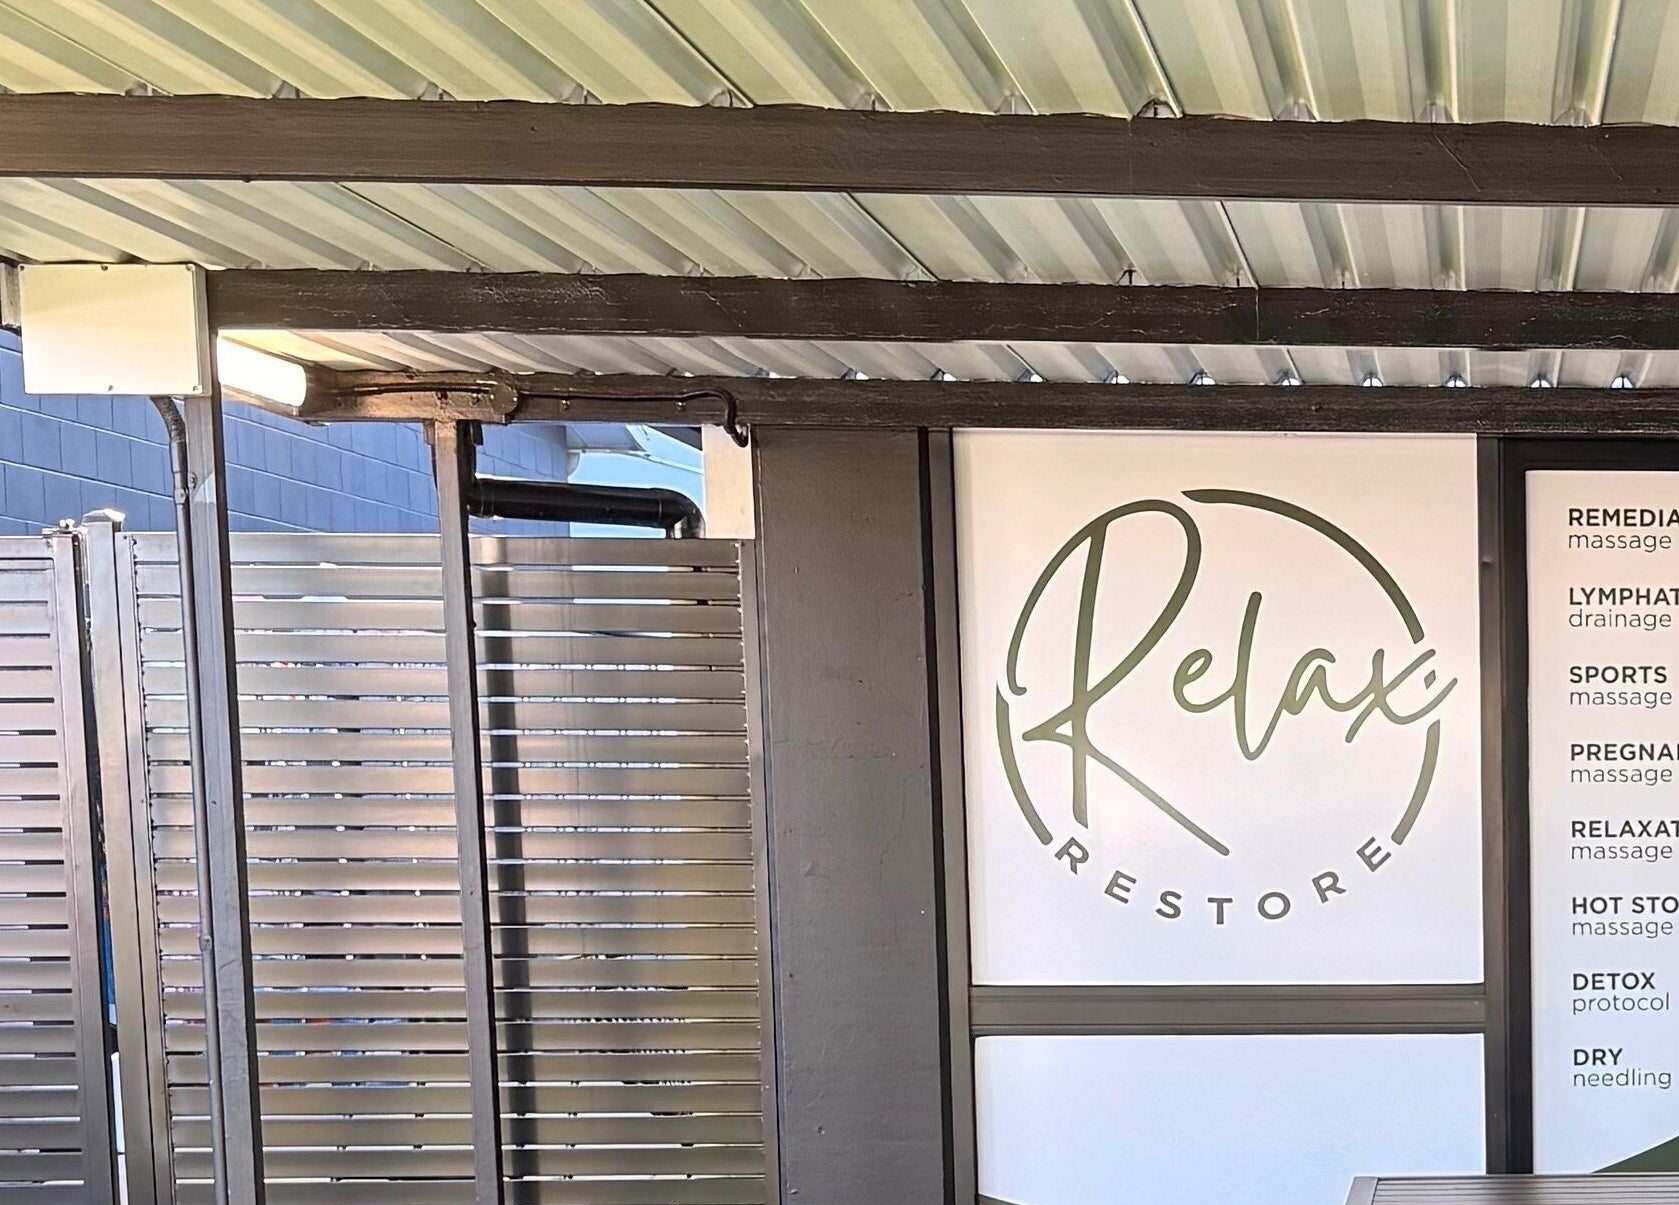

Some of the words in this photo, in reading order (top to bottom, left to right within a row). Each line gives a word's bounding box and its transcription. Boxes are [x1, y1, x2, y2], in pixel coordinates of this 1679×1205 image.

[1568, 533, 1672, 553] massage
[1568, 608, 1672, 632] drainage
[1006, 499, 1458, 857] Relax
[1569, 665, 1668, 684] SPORTS
[1569, 690, 1673, 709] massage
[1570, 767, 1673, 786] massage
[1571, 844, 1673, 863] massage
[1055, 837, 1392, 925] RESTORE
[1572, 896, 1623, 915] HOT
[1572, 919, 1674, 939] massage
[1573, 971, 1656, 991] DETOX
[1573, 992, 1670, 1016] protocol
[1573, 1048, 1623, 1067] DRY
[1573, 1068, 1672, 1090] needling
